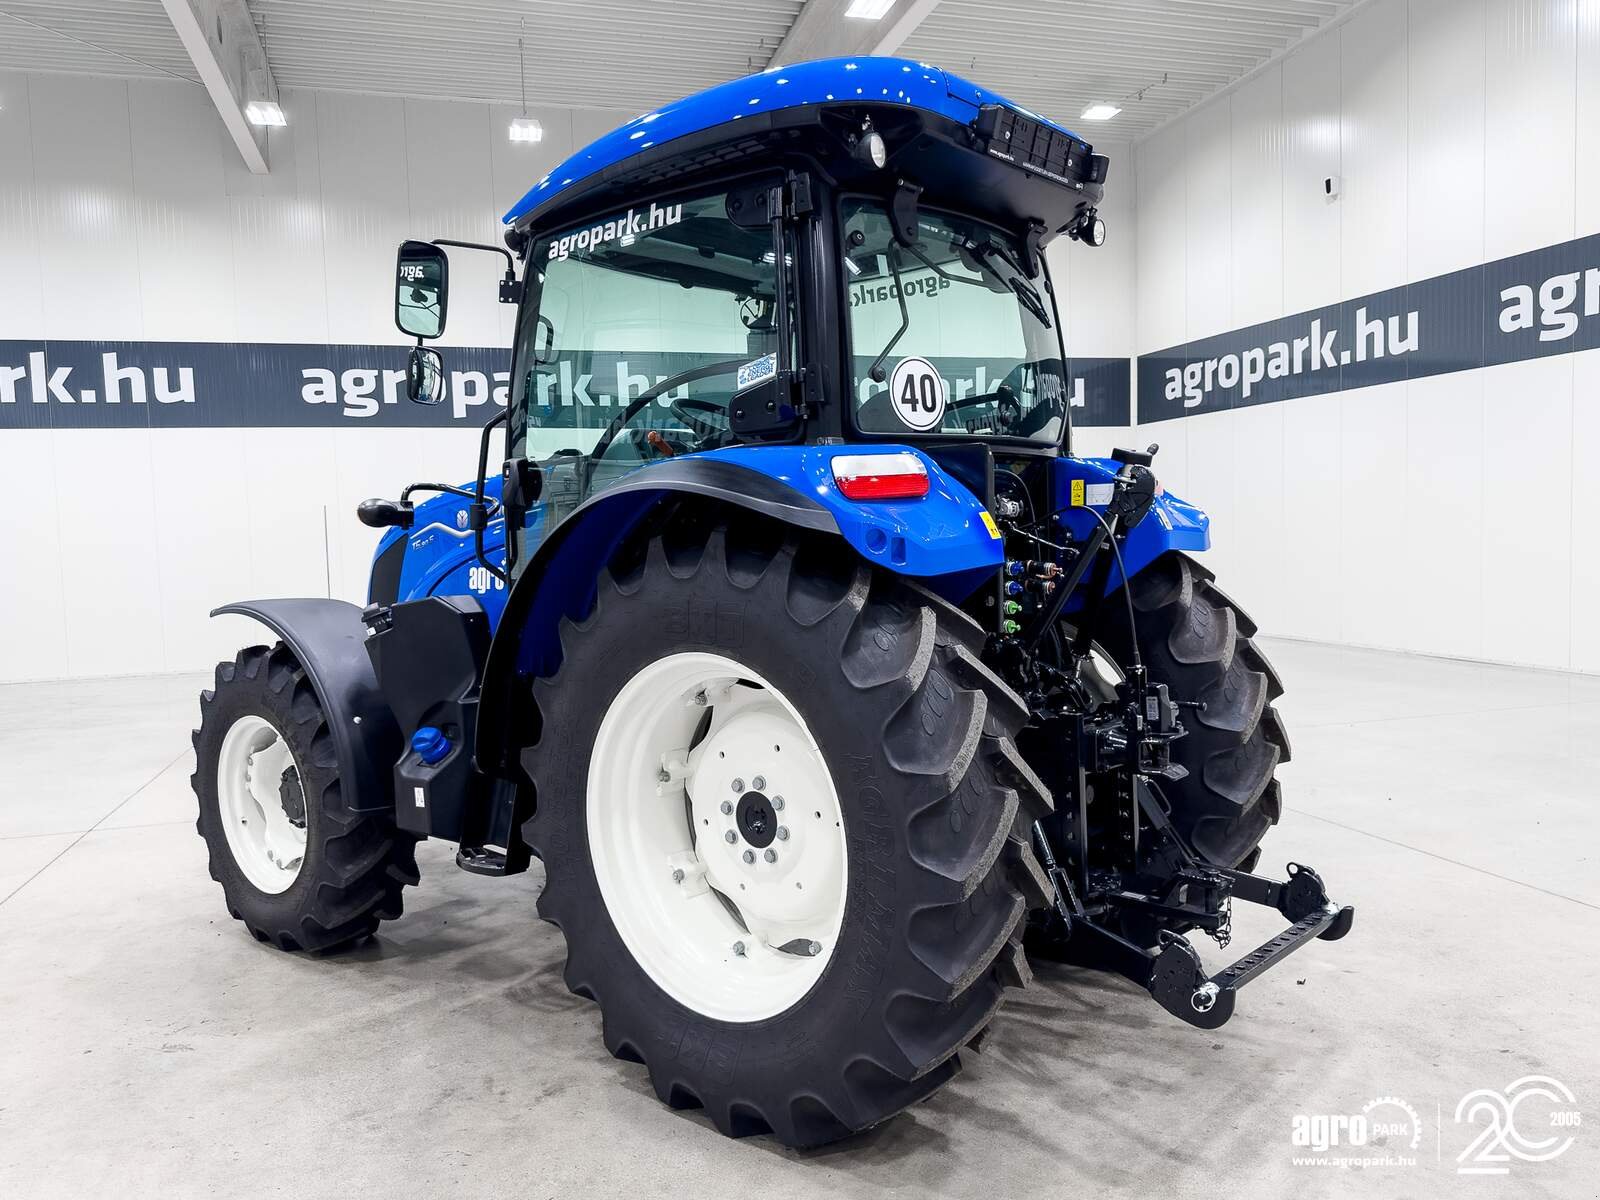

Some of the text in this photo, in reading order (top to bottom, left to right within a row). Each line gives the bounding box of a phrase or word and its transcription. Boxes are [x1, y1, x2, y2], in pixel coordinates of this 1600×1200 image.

[549, 203, 682, 262] agropark.hu
[1164, 307, 1420, 407] agropark.hu
[302, 360, 689, 419] agrpark.hu
[901, 374, 937, 414] 40
